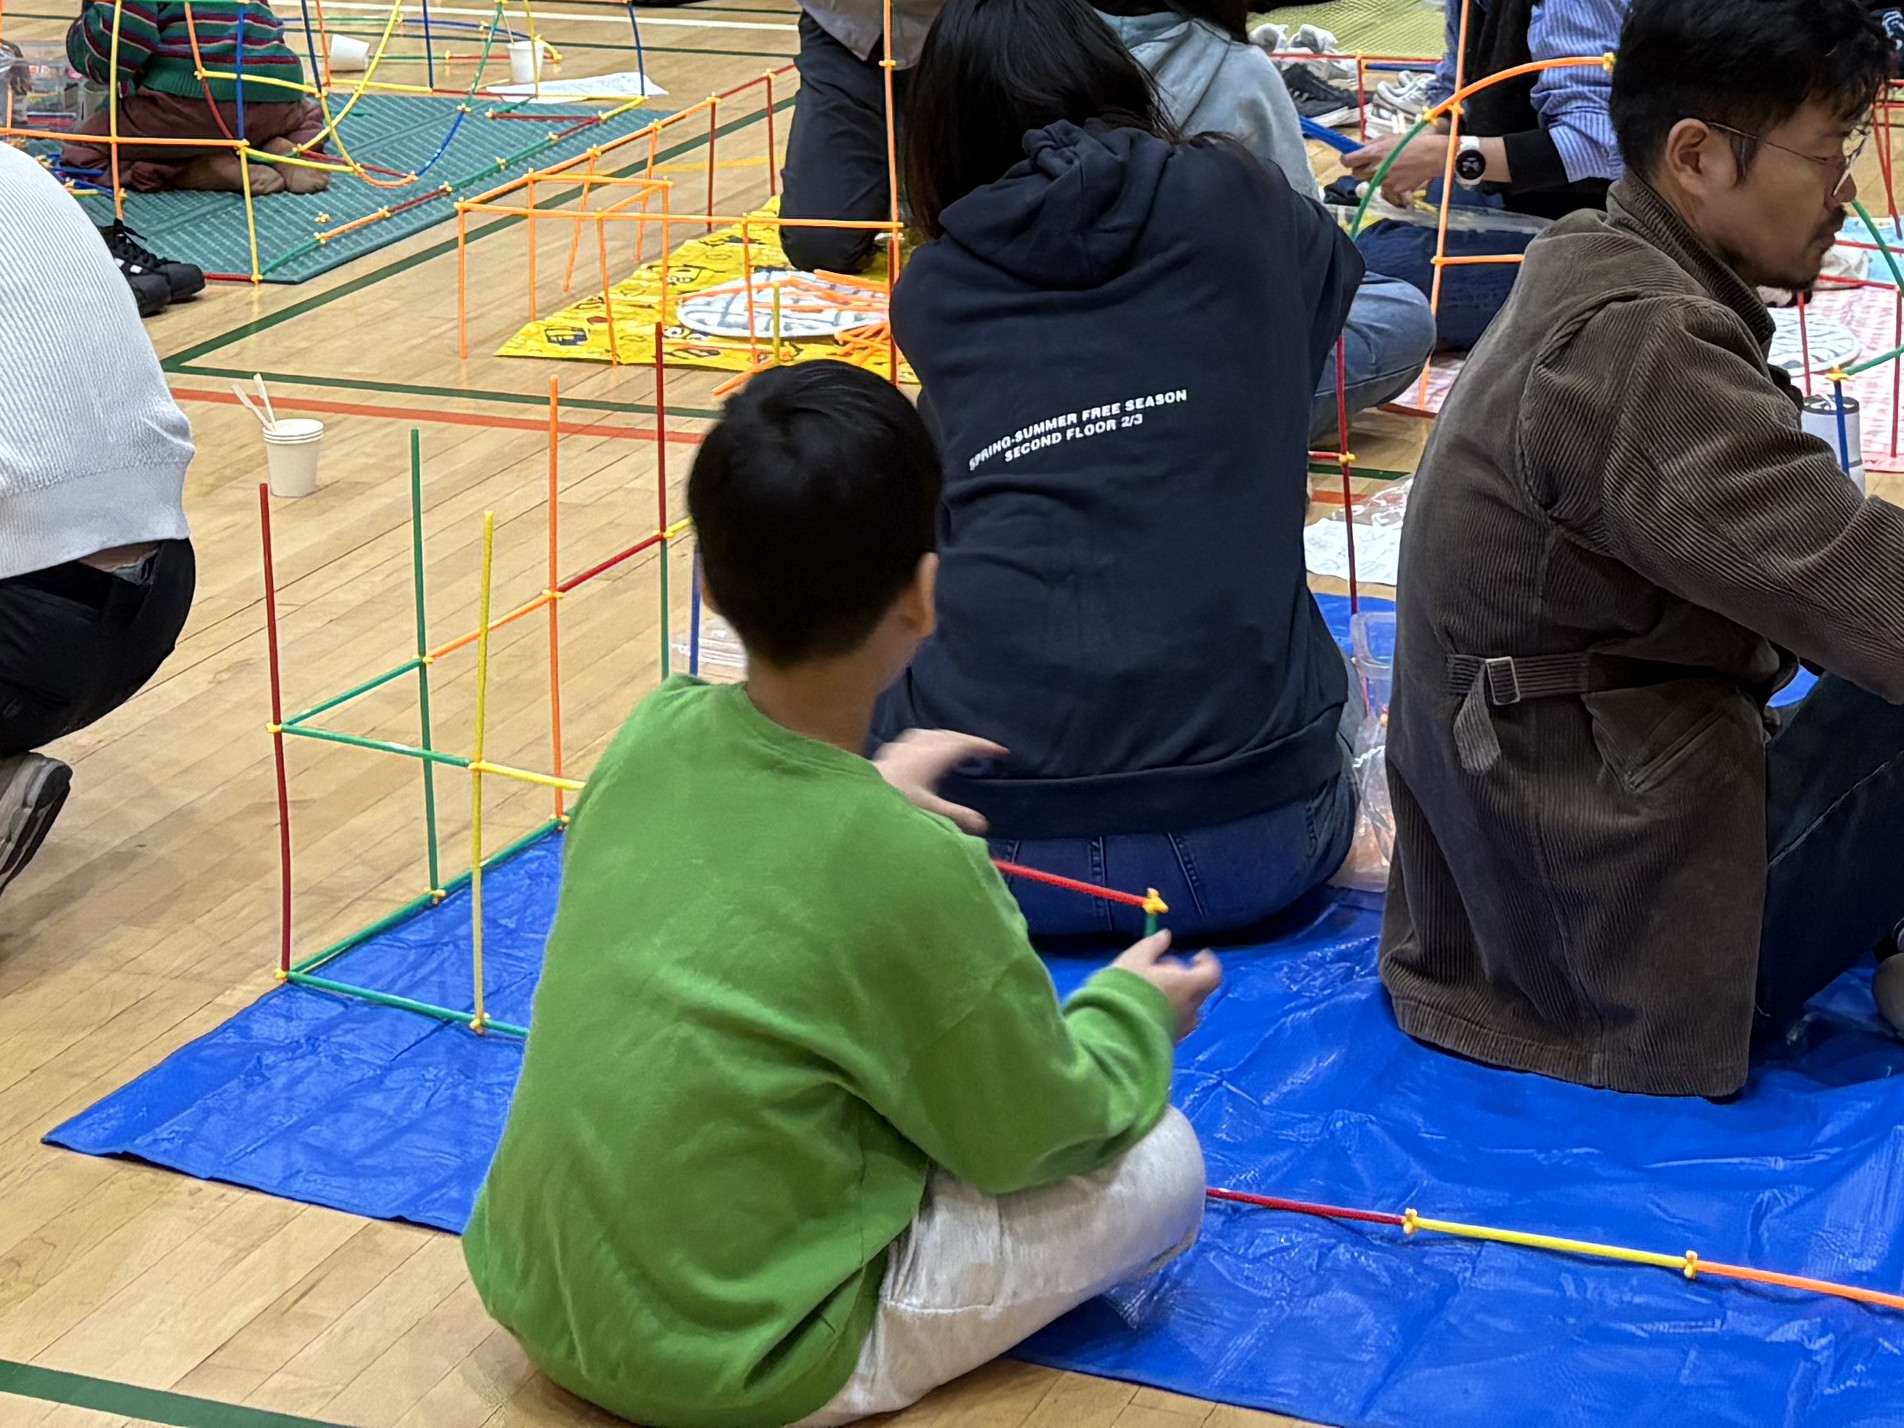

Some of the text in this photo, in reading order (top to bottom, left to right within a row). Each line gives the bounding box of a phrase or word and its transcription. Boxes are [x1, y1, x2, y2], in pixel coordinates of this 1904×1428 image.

[1081, 401, 1121, 421] FREE
[1124, 388, 1188, 412] SEASON
[1003, 413, 1144, 463] SECOND FLOOR 2/3
